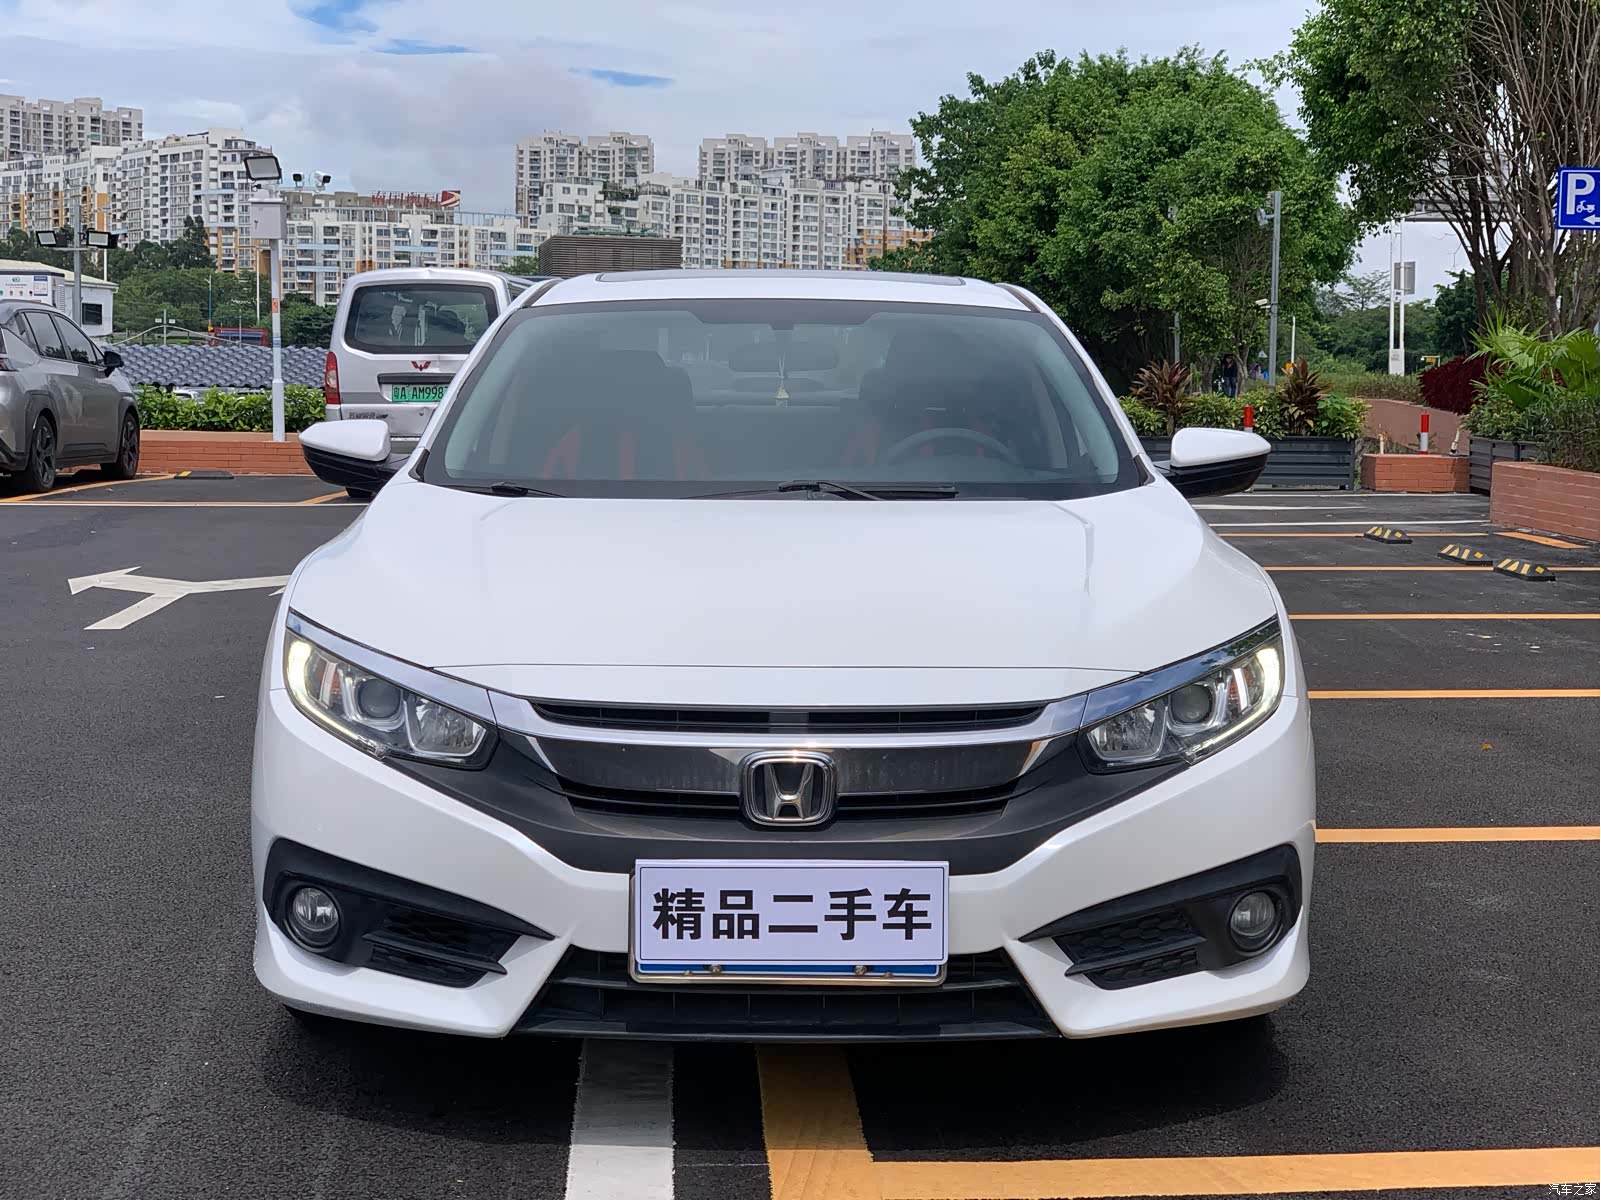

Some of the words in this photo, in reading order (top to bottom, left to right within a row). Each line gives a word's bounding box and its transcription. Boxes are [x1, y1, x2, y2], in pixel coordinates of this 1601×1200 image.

[1566, 173, 1595, 215] P
[653, 888, 932, 941] 精品二手车
